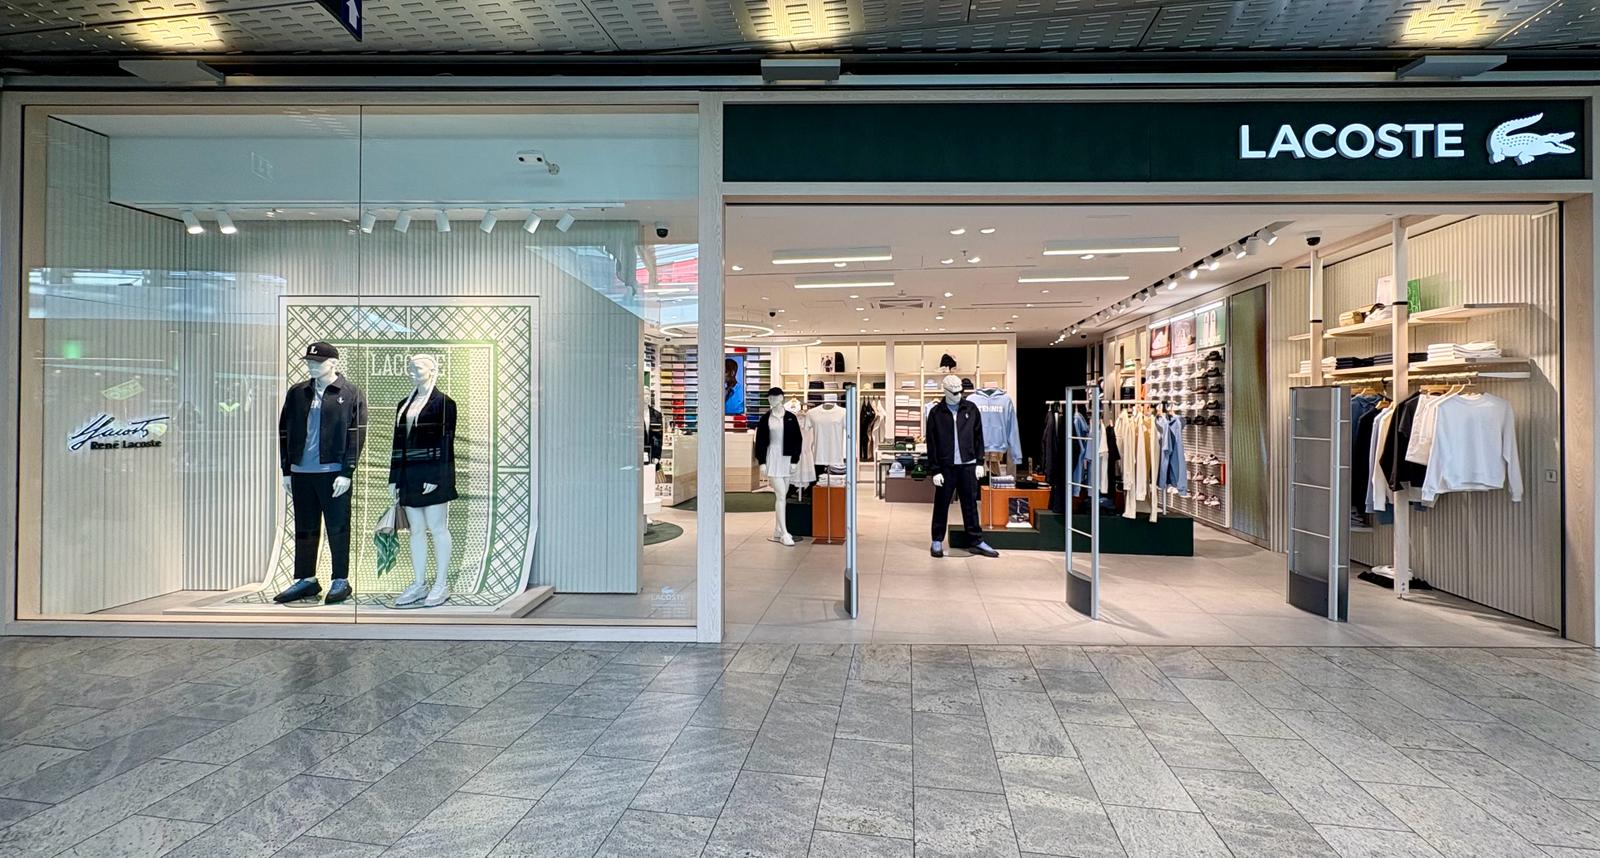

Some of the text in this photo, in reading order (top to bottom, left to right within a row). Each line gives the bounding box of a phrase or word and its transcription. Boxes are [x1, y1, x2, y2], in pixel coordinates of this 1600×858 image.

[1239, 123, 1465, 159] LACOSTE
[309, 346, 318, 354] L
[90, 439, 162, 450] René Lacoste
